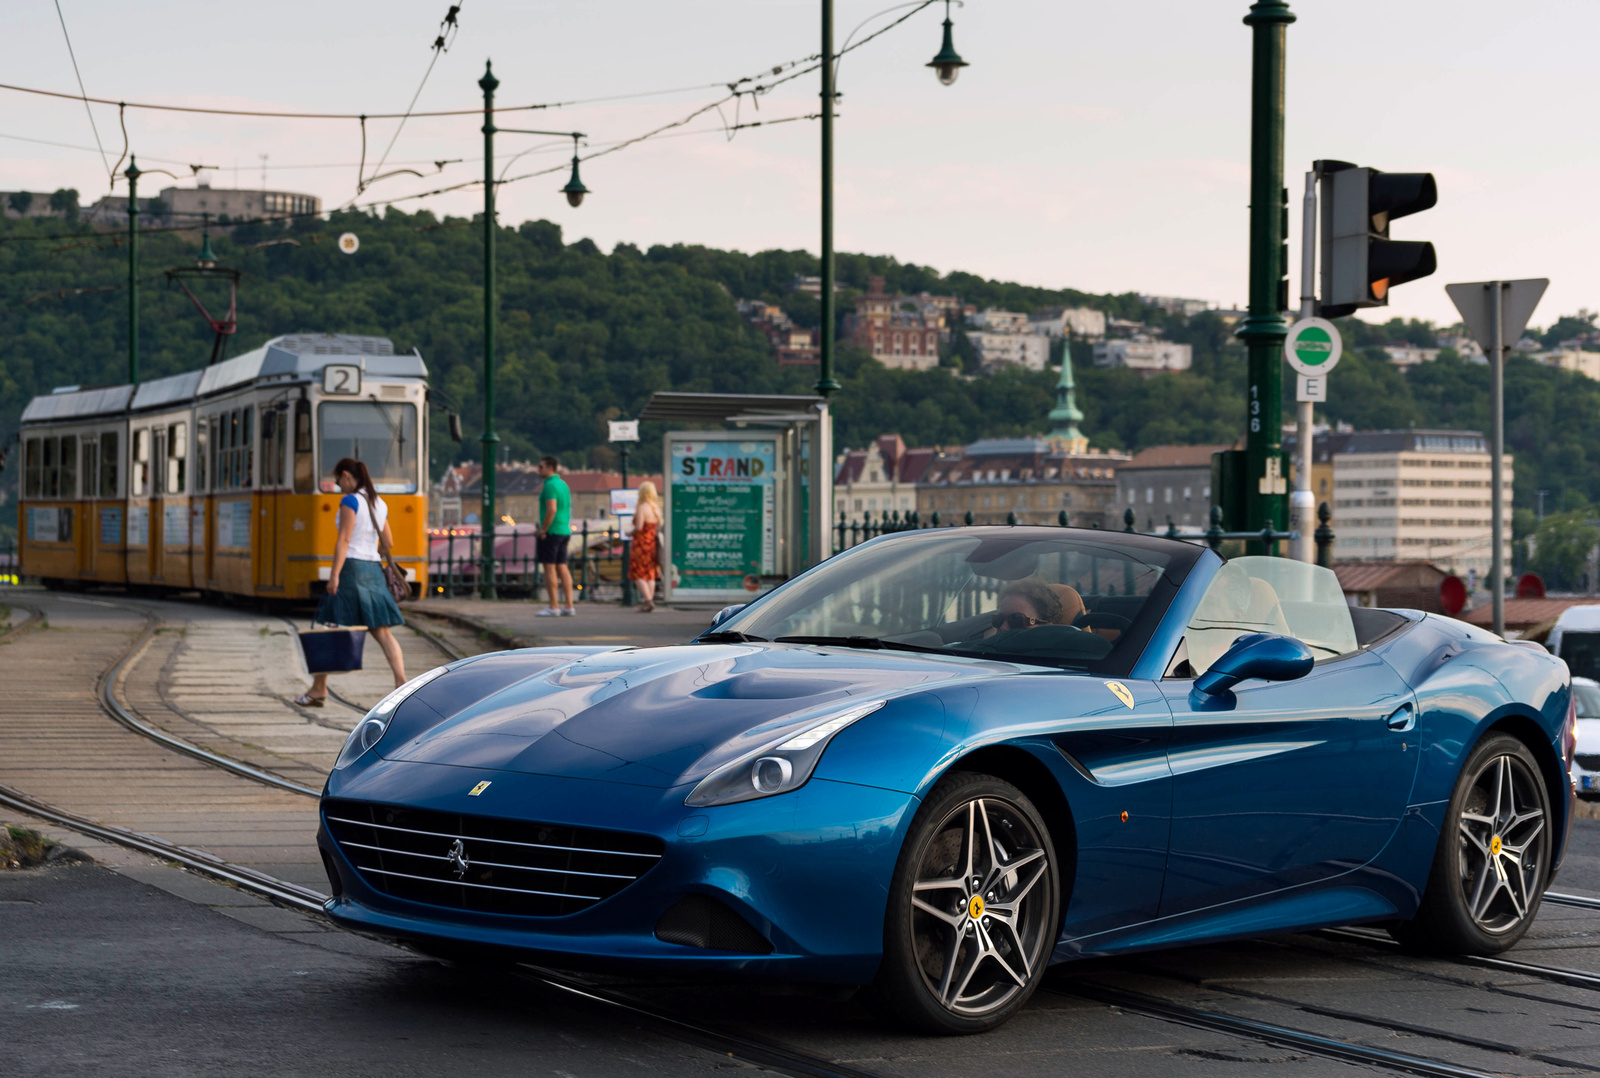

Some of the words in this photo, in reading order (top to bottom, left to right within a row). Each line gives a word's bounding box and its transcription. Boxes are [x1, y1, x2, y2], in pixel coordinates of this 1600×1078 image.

[335, 370, 350, 392] 2
[1306, 379, 1318, 395] E
[682, 457, 764, 476] STRAND
